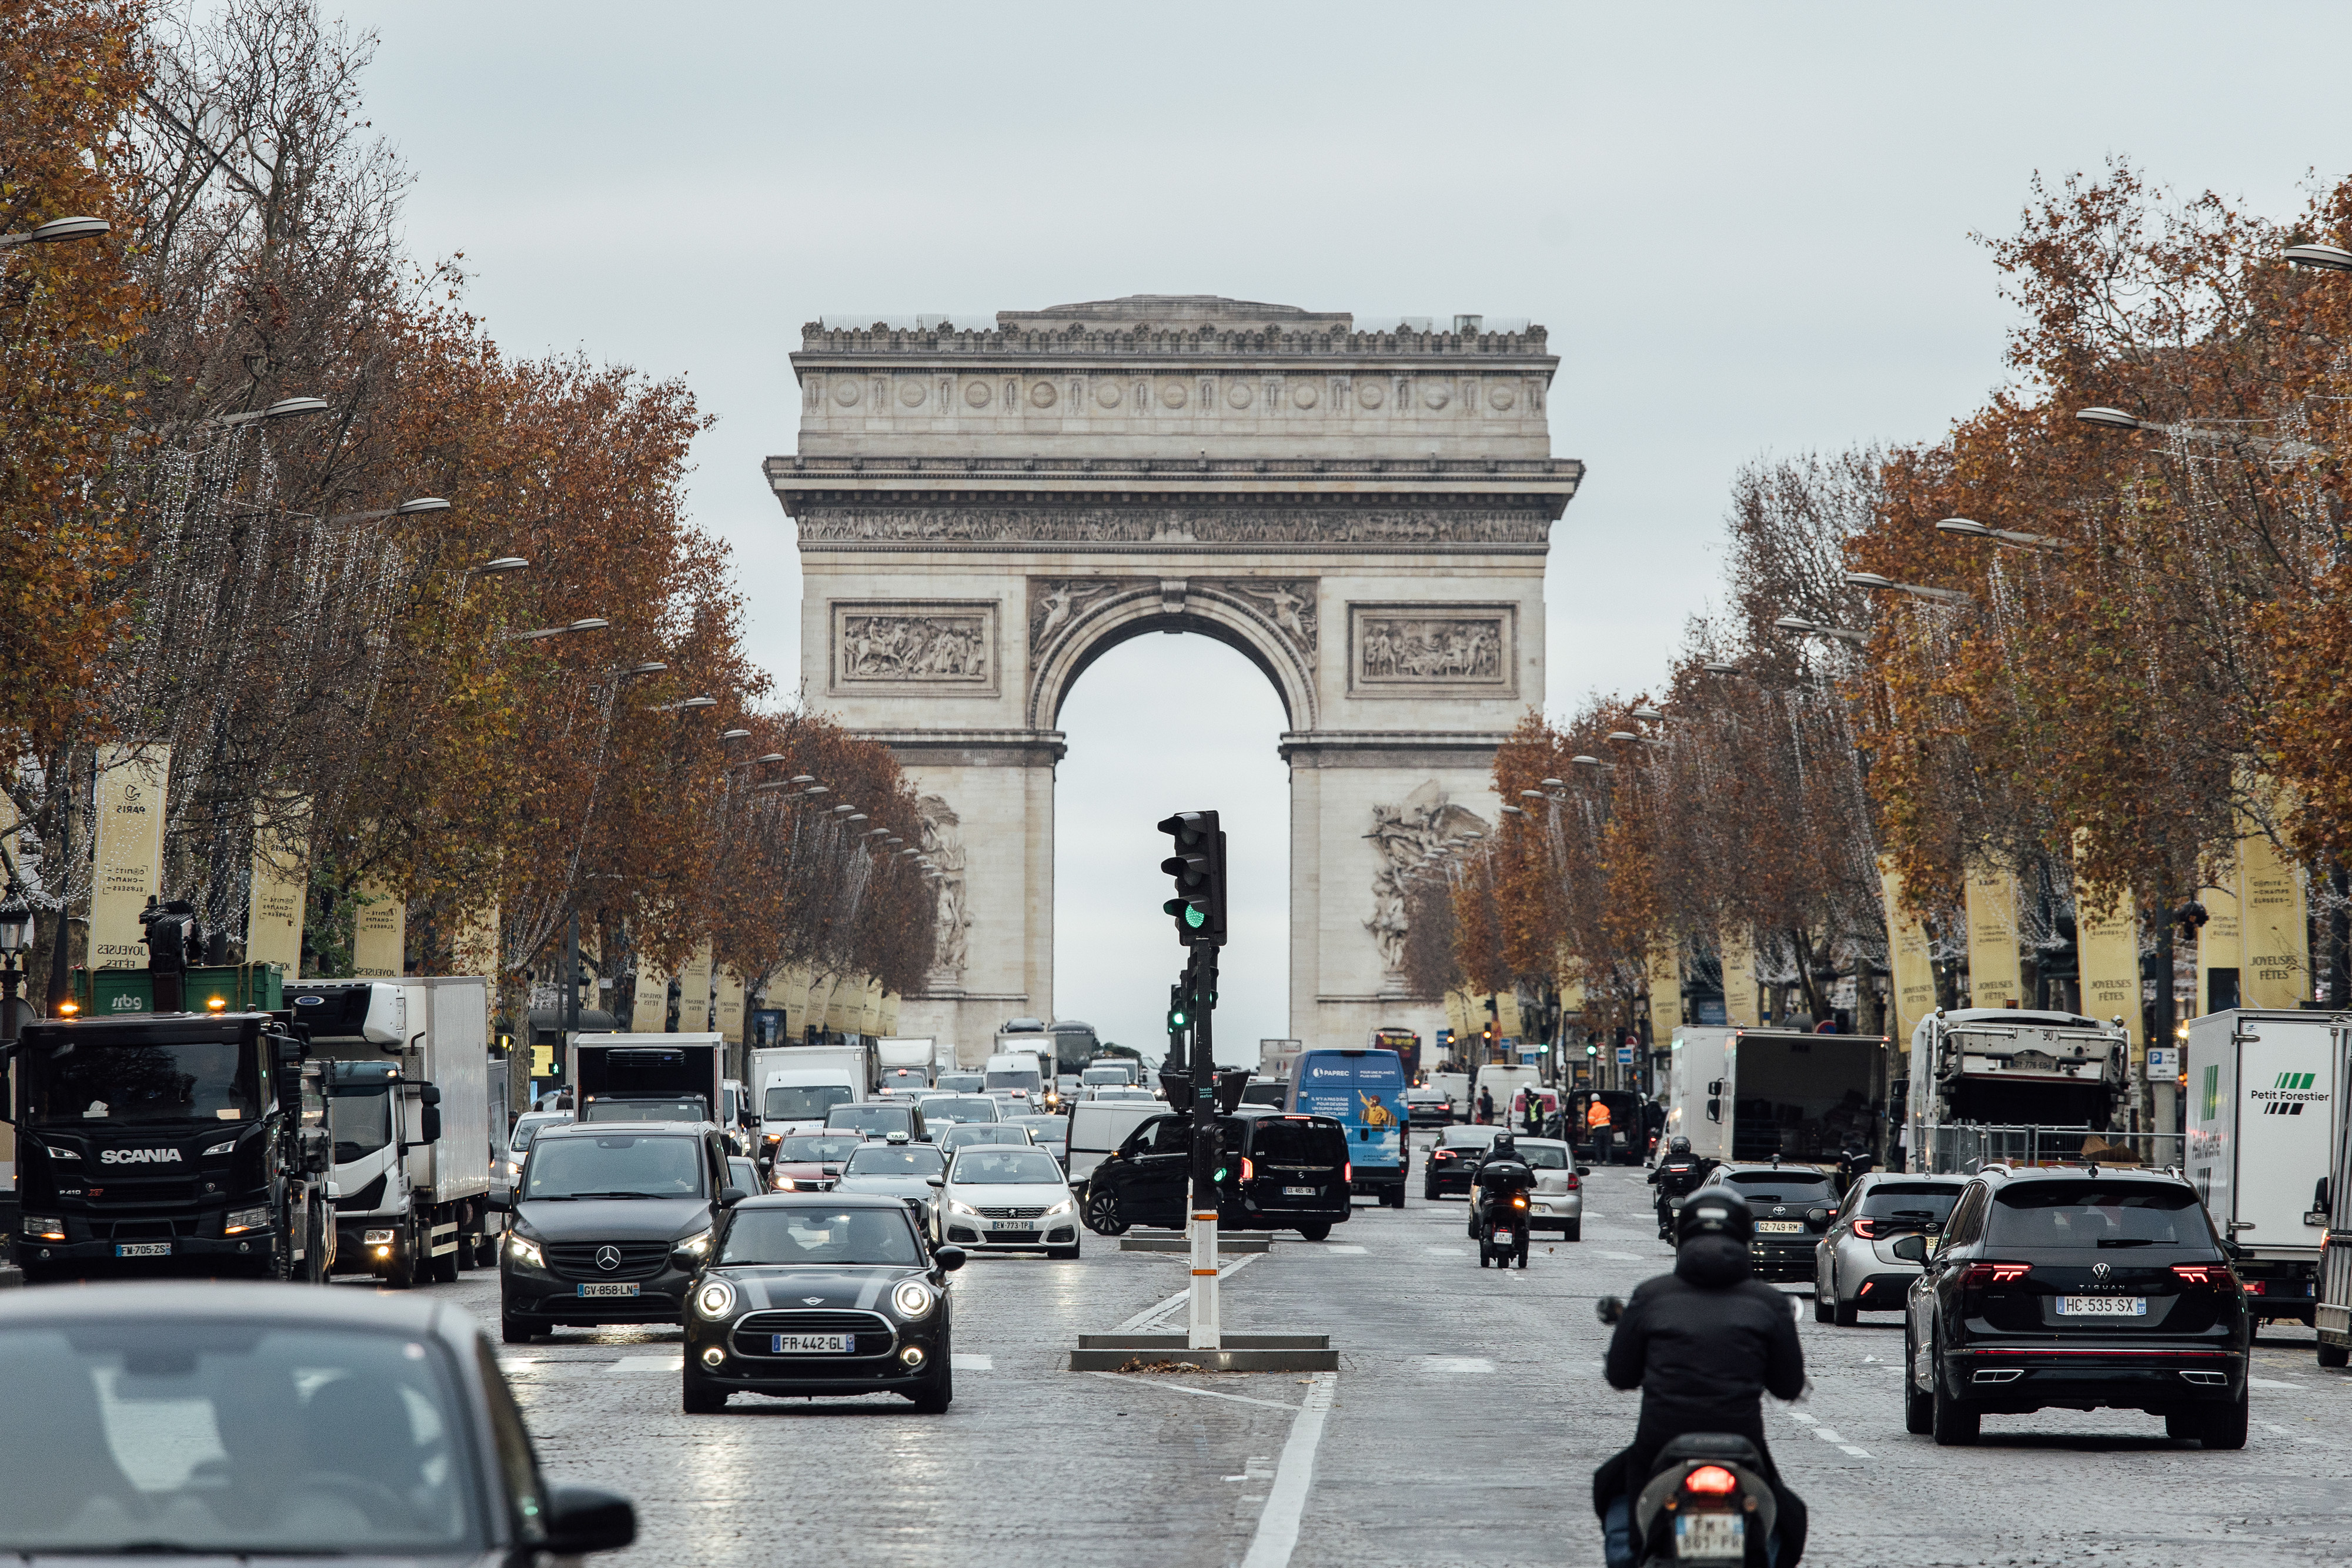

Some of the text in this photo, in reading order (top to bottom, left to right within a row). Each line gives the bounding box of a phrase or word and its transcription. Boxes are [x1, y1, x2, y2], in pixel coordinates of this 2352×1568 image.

[2250, 955, 2297, 966] JOYEUSES
[2260, 968, 2288, 980] FÊTES
[2091, 979, 2132, 989] JOYEUSES
[2251, 1090, 2330, 1101] Petit Forestier
[101, 1148, 183, 1164] SCANIA
[584, 1285, 633, 1295] GV-858-LN
[2066, 1298, 2133, 1312] HC-535-SX
[782, 1337, 844, 1350] FR-442-GL
